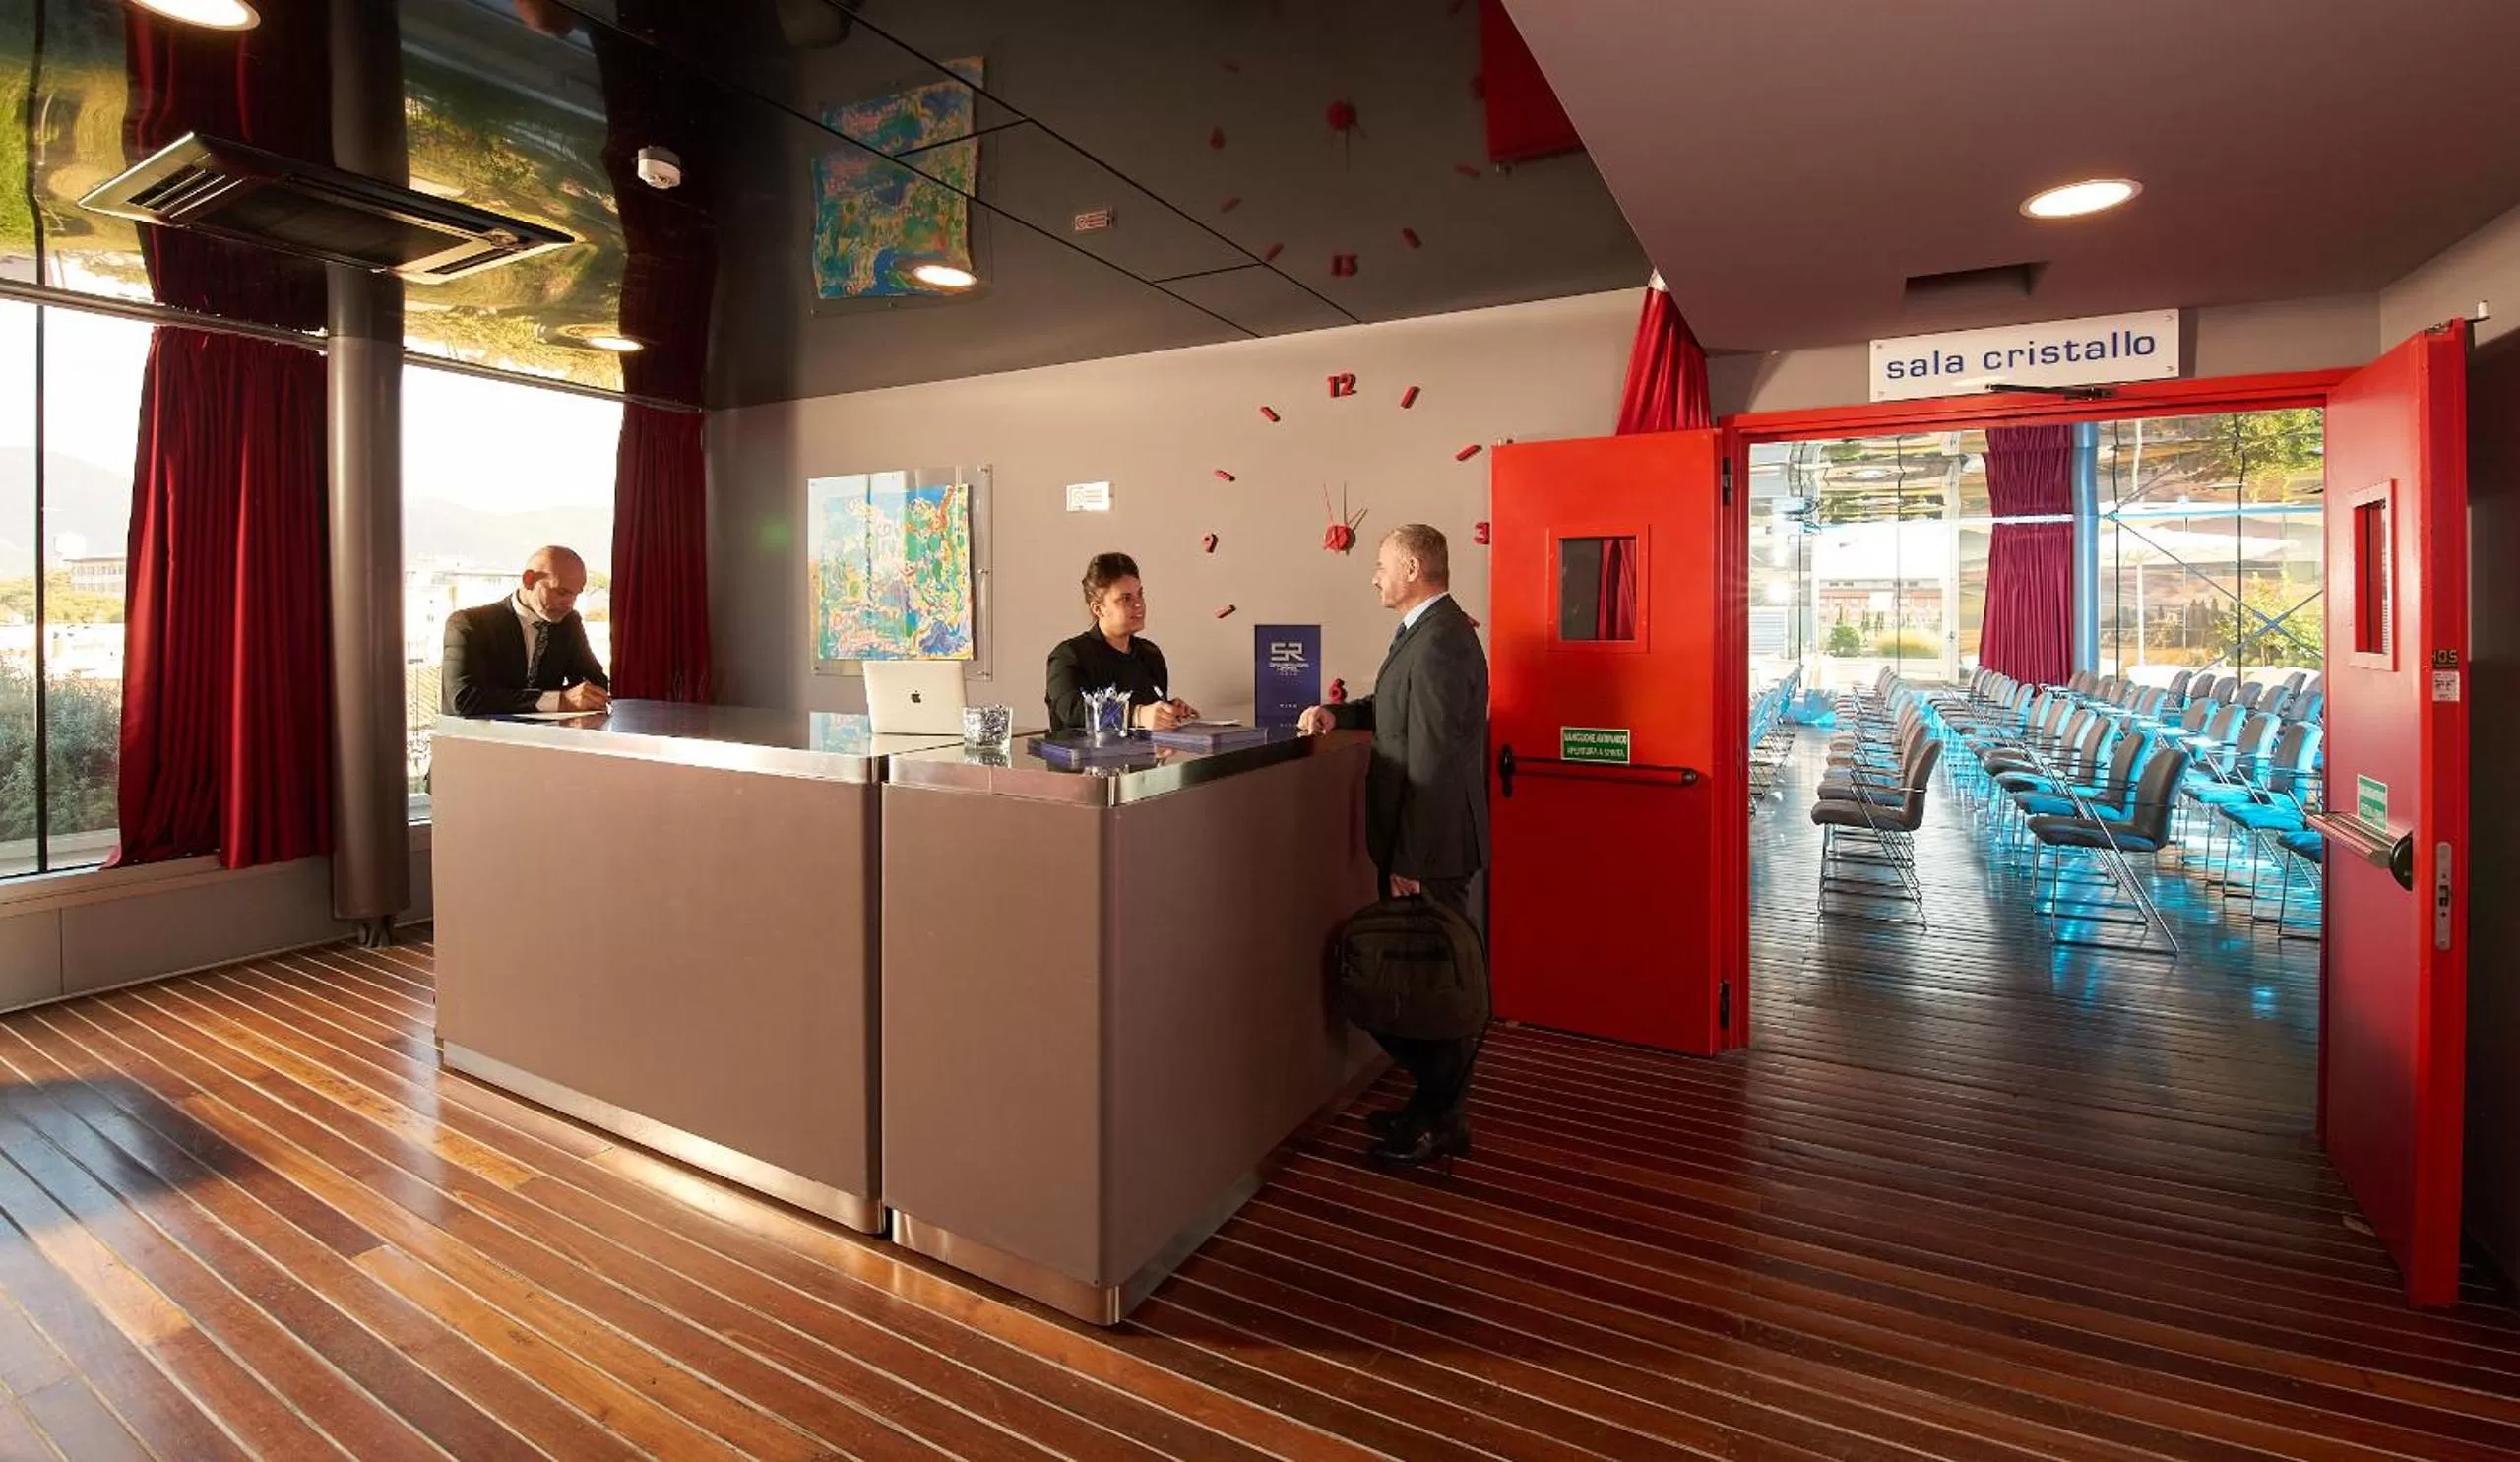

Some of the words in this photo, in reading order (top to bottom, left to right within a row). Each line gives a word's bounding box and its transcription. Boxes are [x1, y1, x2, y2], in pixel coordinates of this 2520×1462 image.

[1887, 350, 1965, 379] sala
[1983, 330, 2156, 371] cristallo
[1328, 372, 1357, 398] 12
[1473, 521, 1491, 545] 3
[1329, 677, 1348, 703] 6
